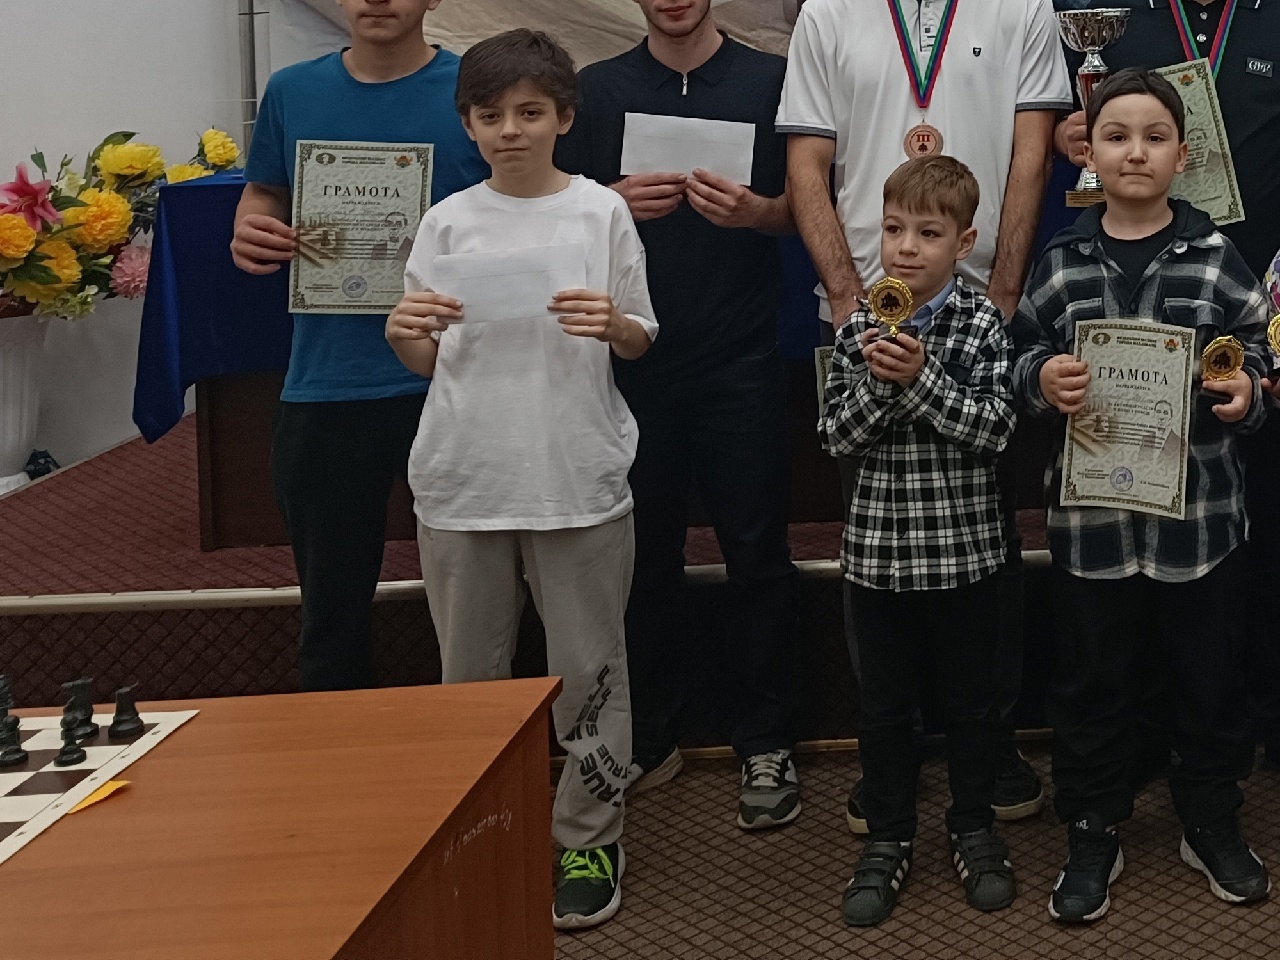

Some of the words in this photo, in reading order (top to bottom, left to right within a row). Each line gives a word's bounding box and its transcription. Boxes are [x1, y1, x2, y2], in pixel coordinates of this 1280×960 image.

[916, 134, 931, 143] III
[323, 185, 401, 199] ГРАМОТА
[1098, 366, 1168, 386] ГРАМОТА
